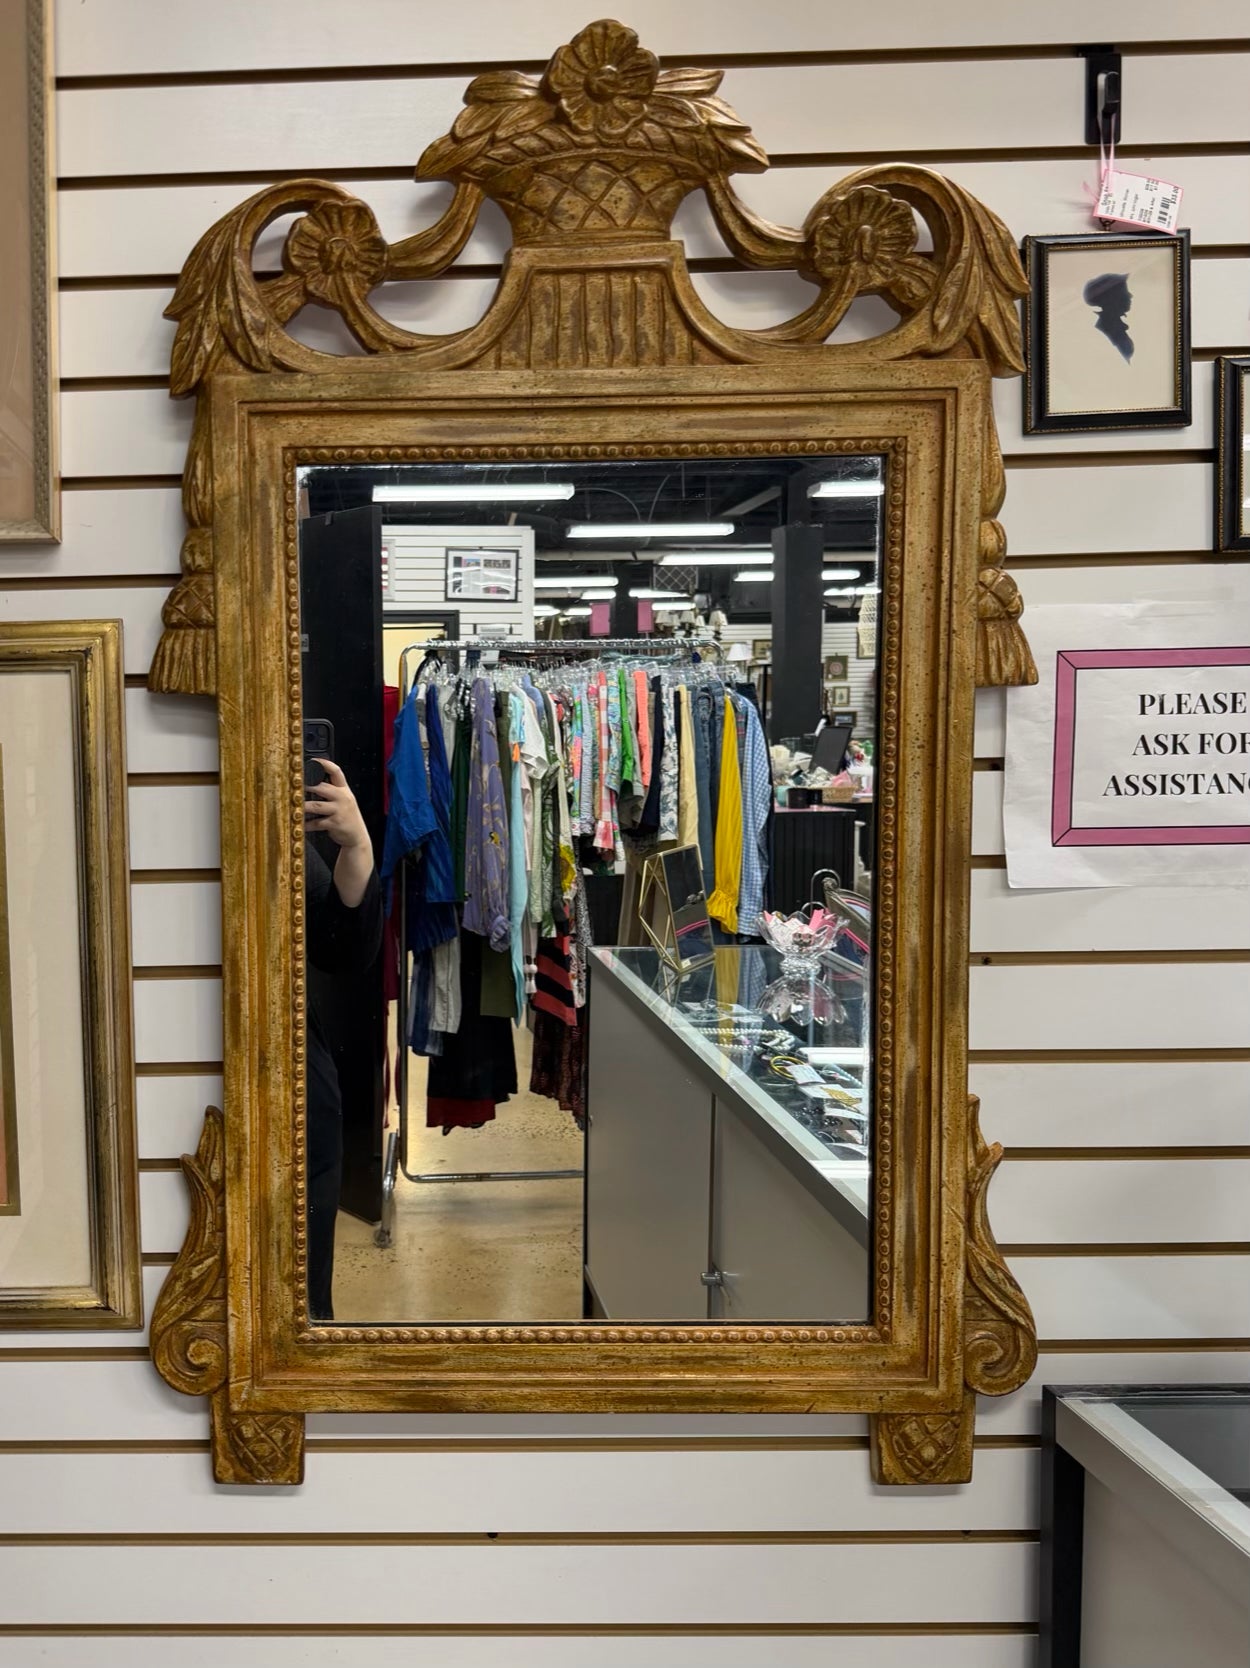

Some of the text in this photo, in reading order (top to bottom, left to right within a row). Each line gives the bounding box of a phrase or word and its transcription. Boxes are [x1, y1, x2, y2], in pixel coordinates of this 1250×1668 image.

[1138, 692, 1247, 716] PLEASE
[1132, 733, 1191, 756] ASK
[1102, 772, 1250, 797] ASSISTAN
